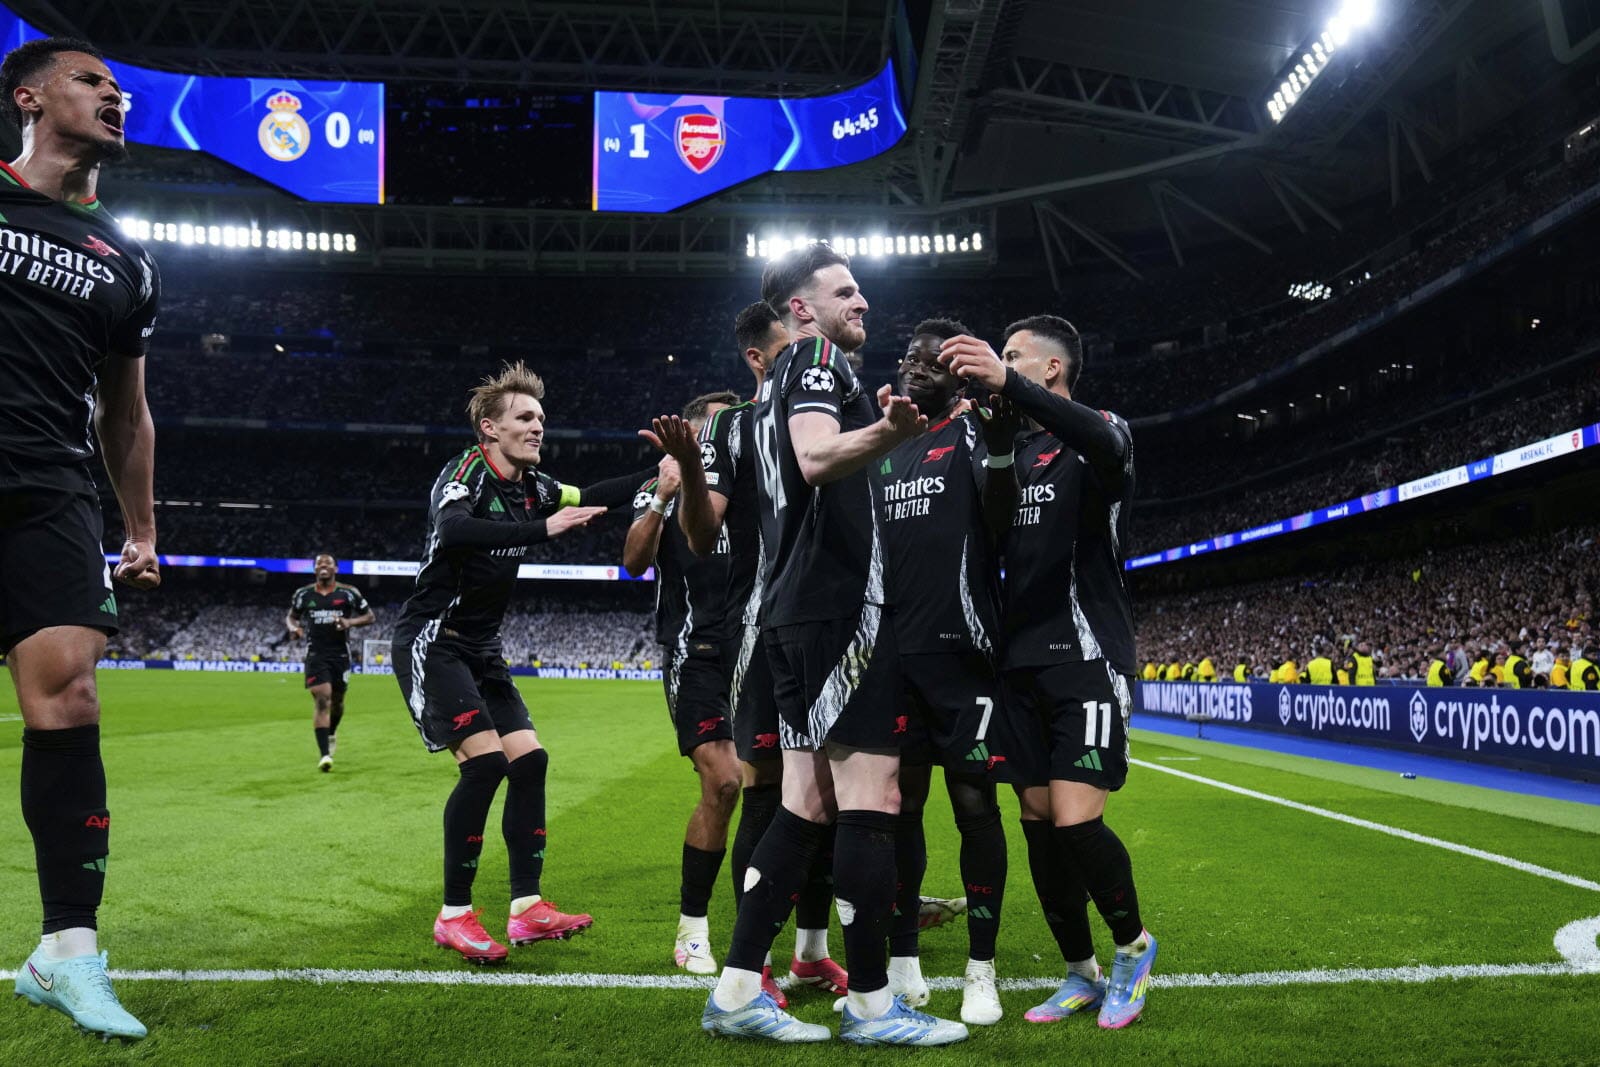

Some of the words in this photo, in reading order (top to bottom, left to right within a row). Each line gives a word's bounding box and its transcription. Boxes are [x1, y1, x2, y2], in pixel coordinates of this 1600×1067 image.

[325, 112, 350, 148] 0
[629, 124, 650, 158] 1
[833, 107, 879, 139] 64:45
[0, 228, 115, 284] mirates
[0, 252, 25, 275] LY
[27, 260, 95, 300] BETTER
[884, 476, 945, 501] mirates
[895, 498, 931, 520] BETTER
[173, 660, 201, 671] WIN
[203, 661, 255, 672] MATCH
[257, 662, 305, 673] TICKET
[538, 668, 565, 679] WIN
[566, 669, 617, 679] MATCH
[975, 697, 994, 740] 7
[1142, 683, 1160, 711] WIN
[1161, 683, 1198, 716] MATCH
[1199, 684, 1252, 722] TICKETS
[1294, 689, 1391, 731] crypto.com
[1082, 700, 1112, 748] 11
[1434, 694, 1600, 757] crypto.com
[967, 883, 993, 895] AFC
